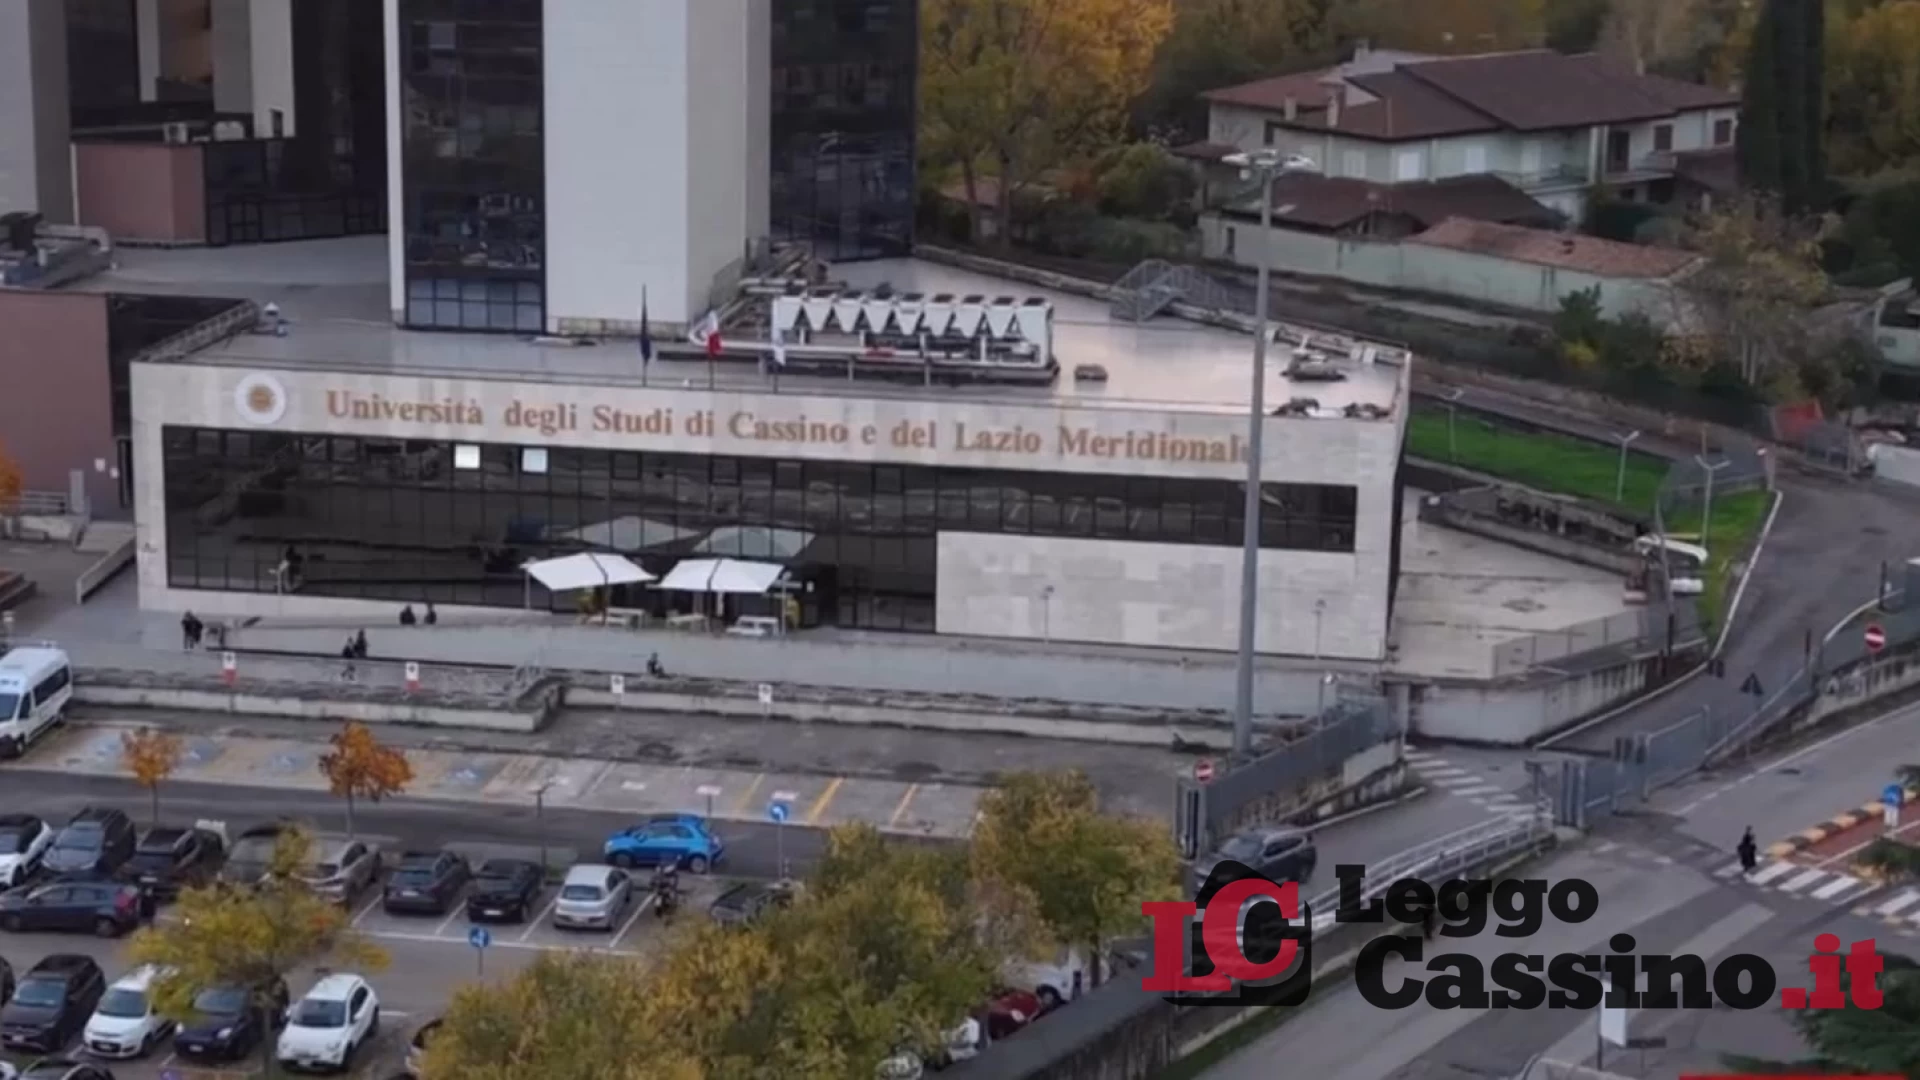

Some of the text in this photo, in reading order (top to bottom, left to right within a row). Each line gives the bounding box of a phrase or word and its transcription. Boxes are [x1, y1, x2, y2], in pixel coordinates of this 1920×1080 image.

[326, 389, 485, 426] Università
[504, 400, 578, 435] degli
[592, 405, 673, 436] Studi
[685, 410, 716, 438] di
[729, 411, 849, 444] Cassino
[861, 427, 877, 446] e
[889, 420, 936, 449] del
[954, 422, 1042, 454] Lazio
